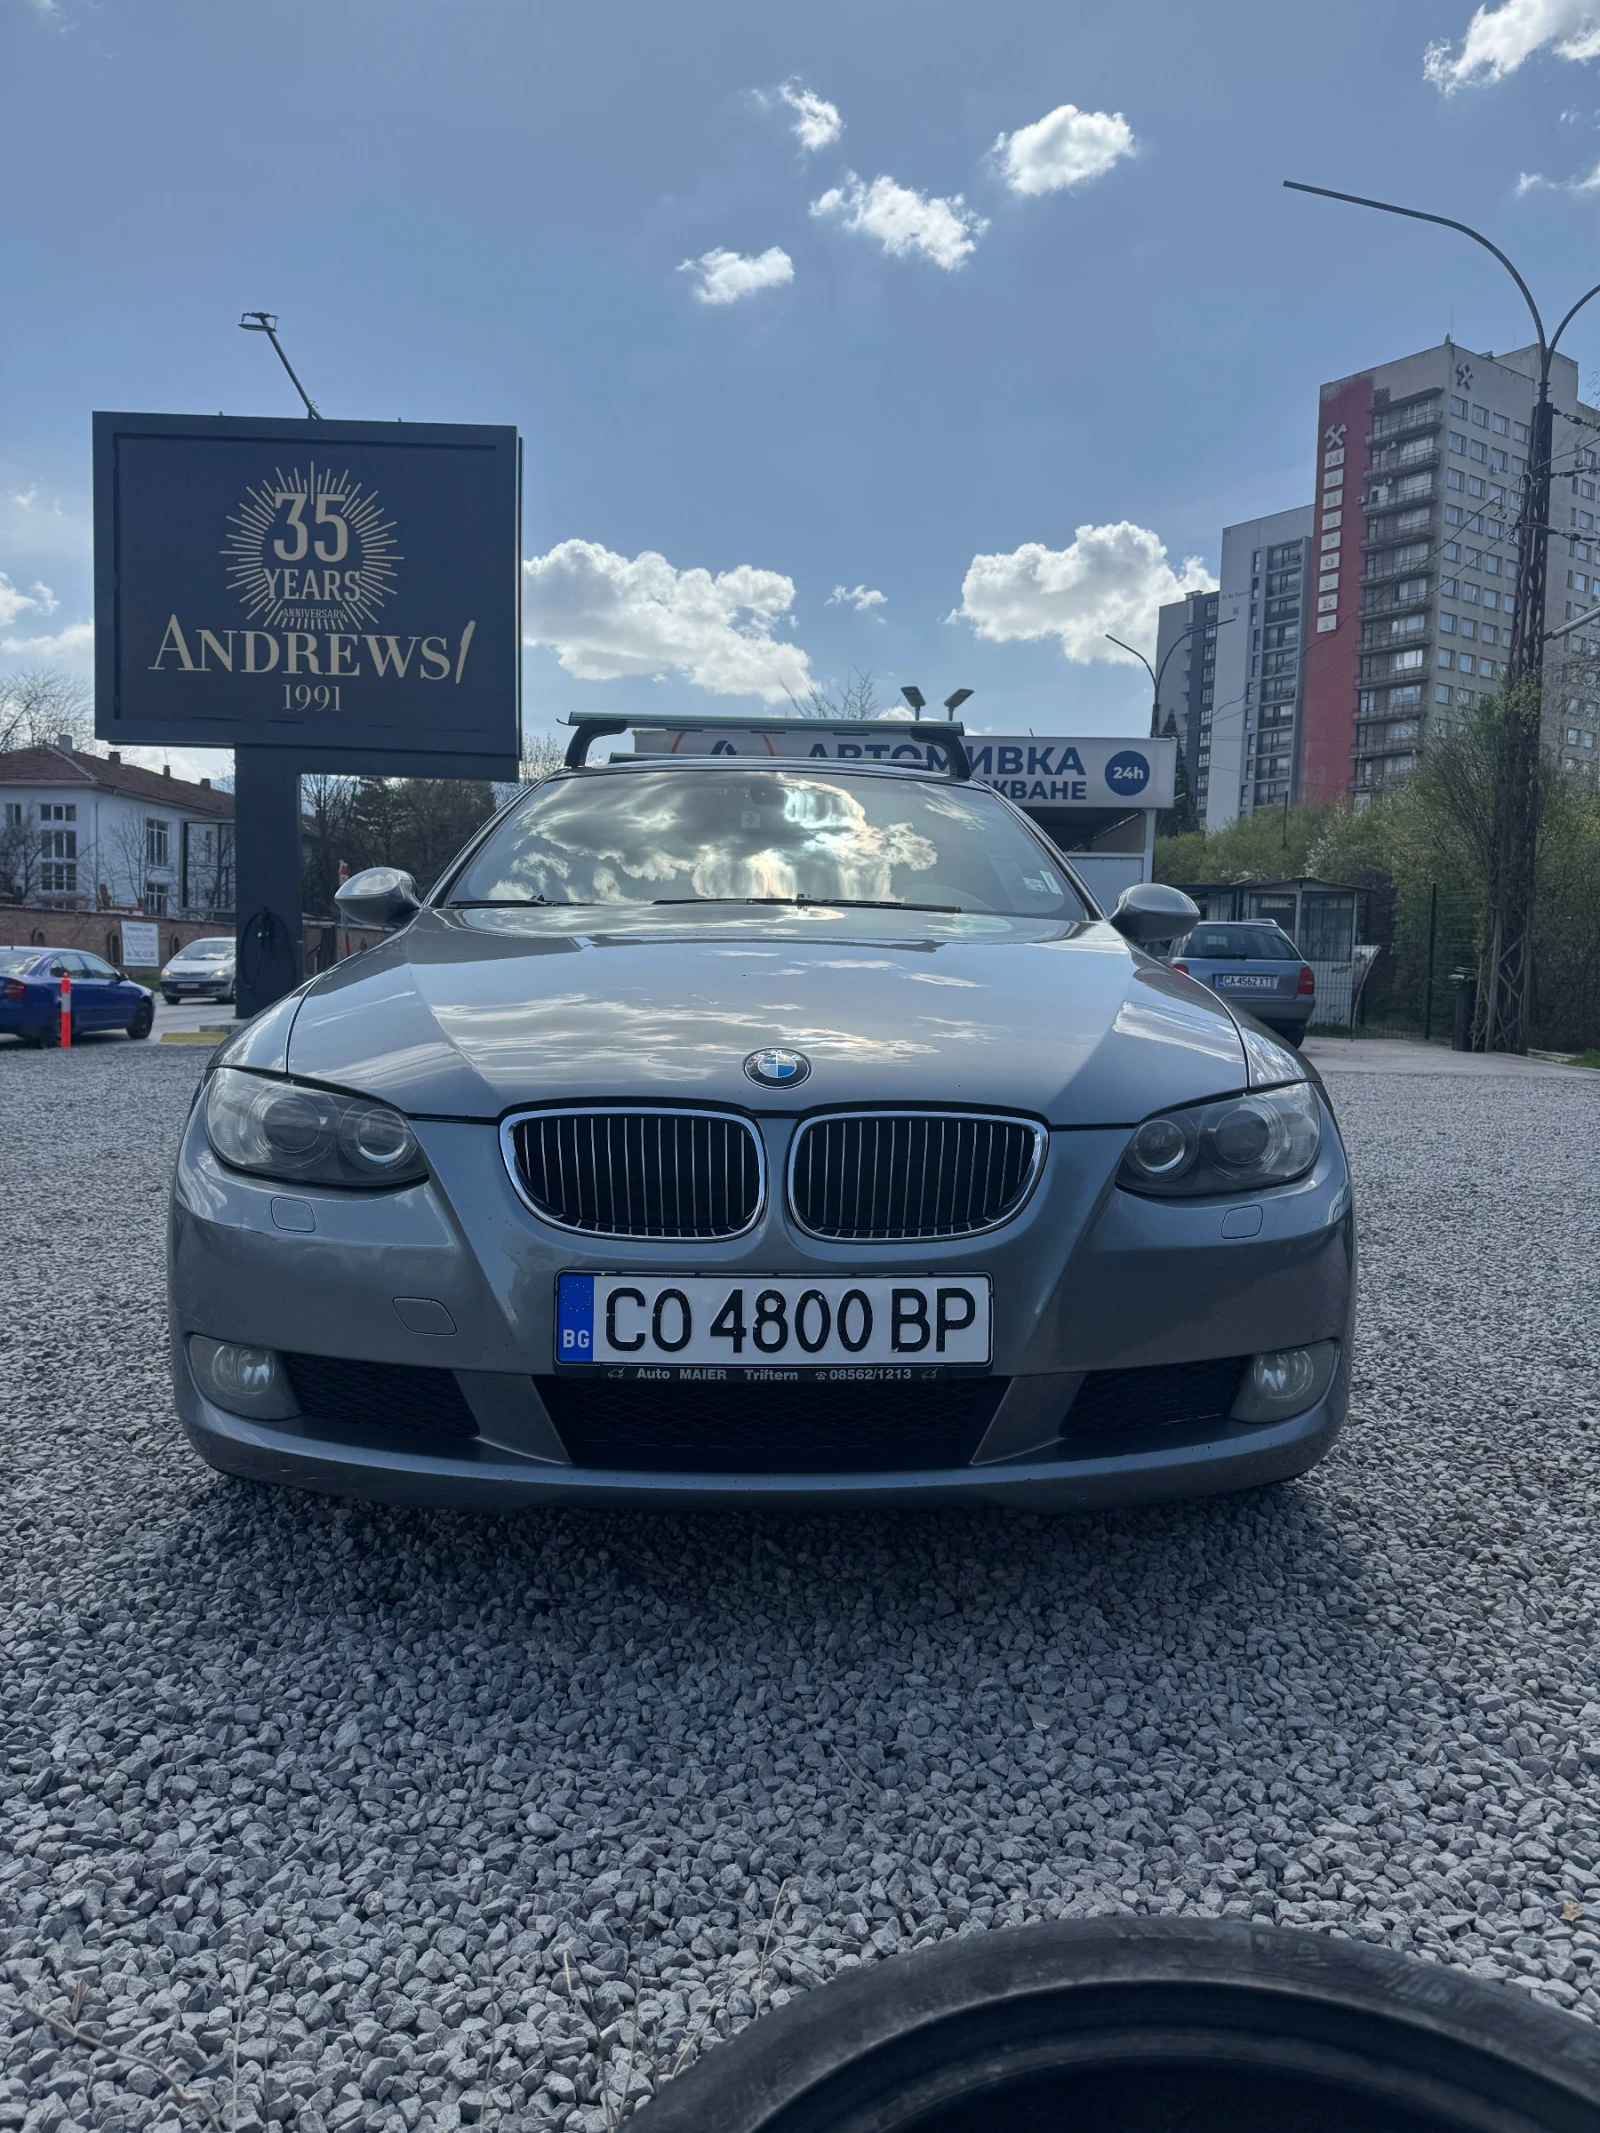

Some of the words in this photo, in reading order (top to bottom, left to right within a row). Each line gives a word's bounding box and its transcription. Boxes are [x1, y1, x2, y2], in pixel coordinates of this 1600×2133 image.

[273, 492, 348, 563] 35
[263, 569, 361, 602] YEARS
[282, 607, 345, 619] ANNIVERSARY
[282, 684, 344, 712] 1991
[1113, 766, 1144, 780] 24h
[709, 1289, 873, 1353] 4800
[891, 1287, 976, 1353] BP
[563, 1329, 590, 1349] BG
[637, 1369, 671, 1380] Auto
[679, 1369, 727, 1380] MAIER
[744, 1369, 799, 1381] Triftern
[829, 1369, 912, 1381] 08562/1213
